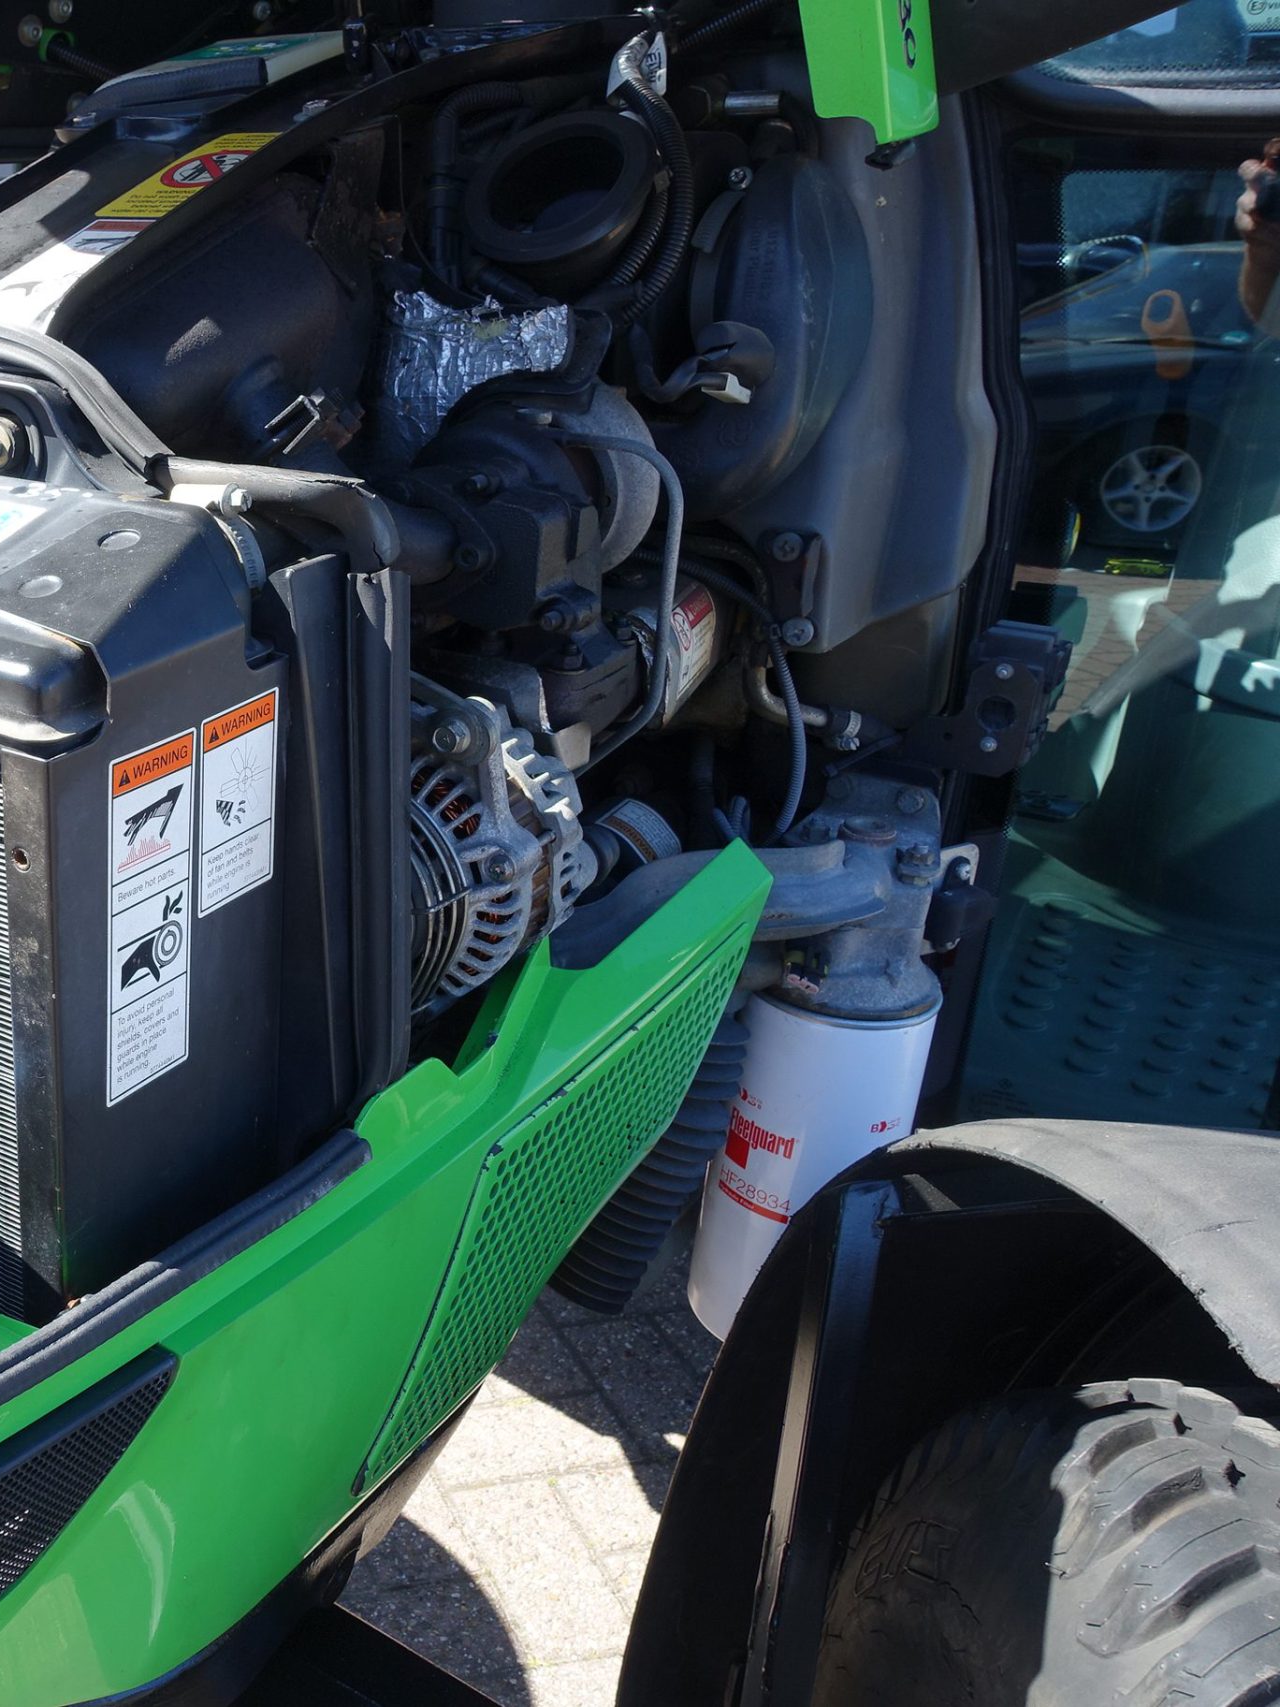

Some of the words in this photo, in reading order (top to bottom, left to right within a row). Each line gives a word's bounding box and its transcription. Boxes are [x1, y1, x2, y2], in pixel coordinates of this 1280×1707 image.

[221, 703, 270, 736] WARNING
[133, 745, 187, 779] WARNING
[207, 867, 215, 878] of
[215, 862, 224, 873] fan
[226, 855, 238, 867] and
[239, 847, 254, 859] belts
[208, 852, 224, 866] Keep
[225, 841, 243, 855] hands
[207, 875, 223, 889] while
[224, 863, 244, 879] engine
[245, 859, 251, 867] is
[118, 884, 144, 903] Beware
[144, 876, 157, 888] hot
[118, 1016, 126, 1026] To
[127, 1005, 145, 1022] avoid
[146, 987, 175, 1011] personal
[138, 1012, 154, 1026] keep
[156, 1005, 164, 1017] all
[143, 1016, 166, 1034] covers
[167, 1007, 179, 1021] and
[117, 1042, 140, 1063] guards
[141, 1038, 148, 1046] in
[149, 1027, 167, 1043] place
[117, 1057, 135, 1072] while
[136, 1043, 158, 1058] engine
[117, 1075, 123, 1083] is
[731, 1105, 795, 1159] Fleetguard
[720, 1165, 791, 1213] HF28934
